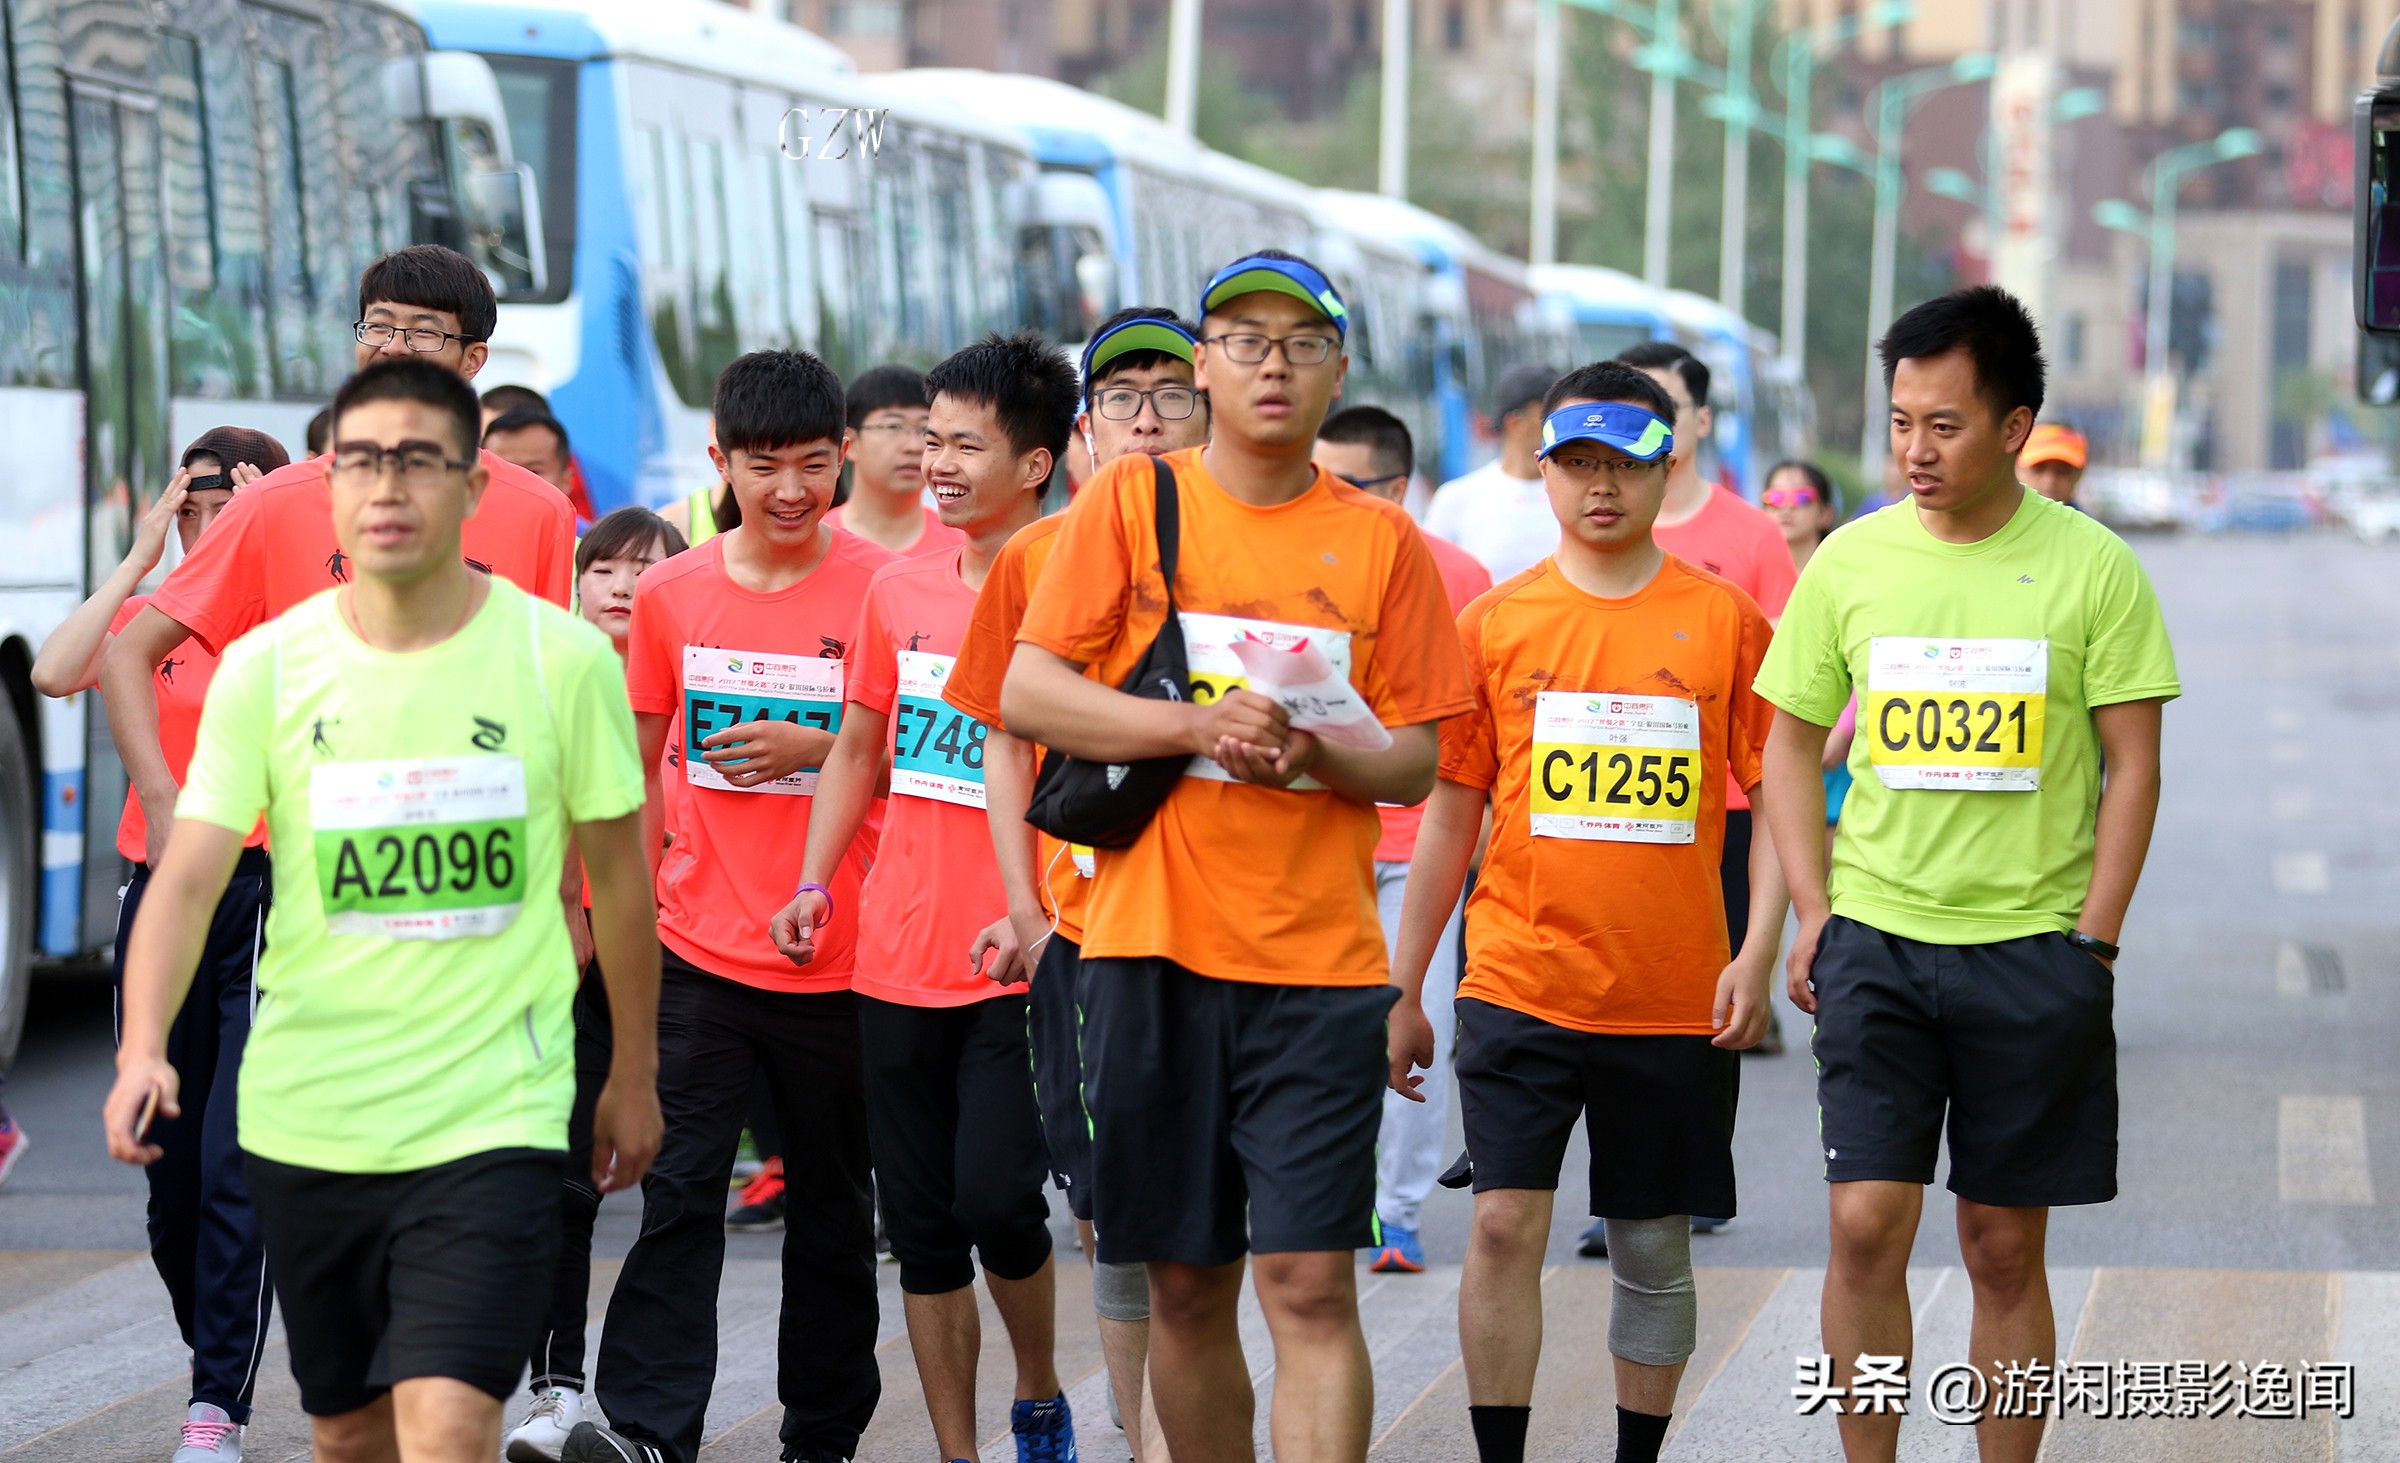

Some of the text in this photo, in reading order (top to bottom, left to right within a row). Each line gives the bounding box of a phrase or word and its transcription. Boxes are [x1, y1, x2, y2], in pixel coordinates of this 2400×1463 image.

[1879, 697, 2026, 754] C0321
[1542, 749, 1690, 808] C1255
[332, 827, 515, 899] A2096
